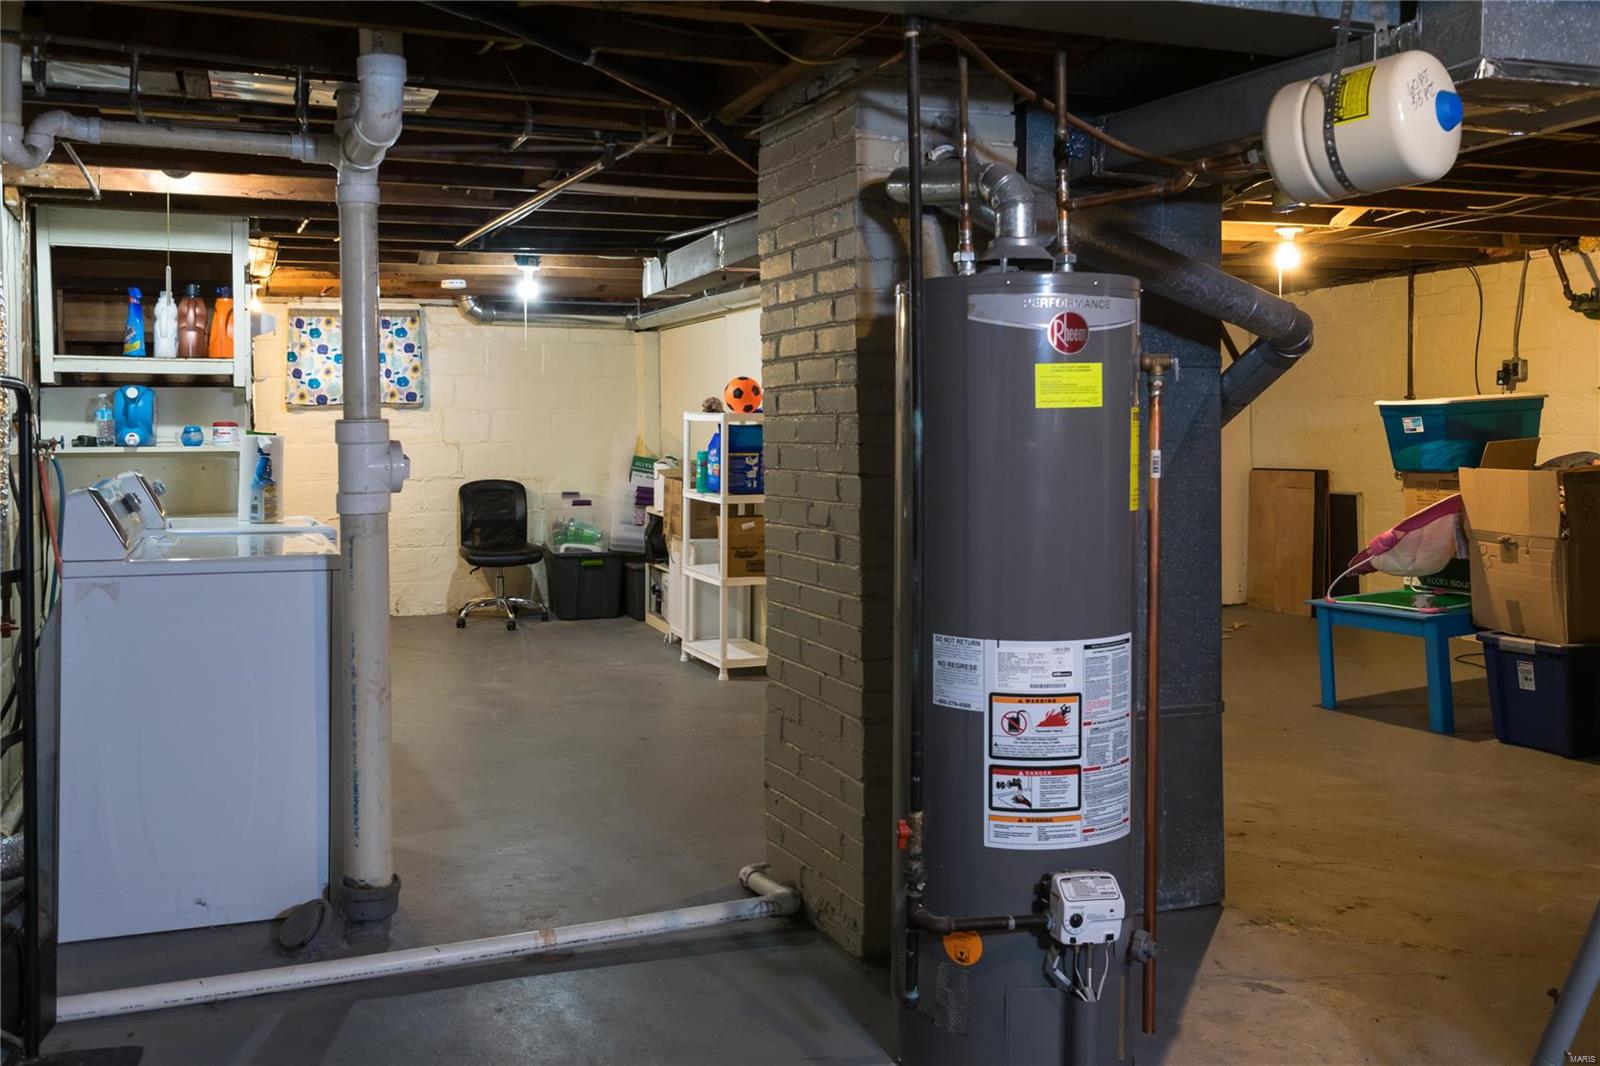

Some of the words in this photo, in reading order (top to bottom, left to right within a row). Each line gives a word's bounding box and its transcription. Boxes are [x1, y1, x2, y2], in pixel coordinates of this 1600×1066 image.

[1023, 298, 1111, 310] PERFORMANCE
[1053, 312, 1087, 348] Rheem
[935, 635, 944, 643] DO
[944, 636, 956, 644] NOT
[956, 638, 981, 647] RETURN
[937, 660, 946, 668] NO
[947, 661, 978, 672] REGRESE
